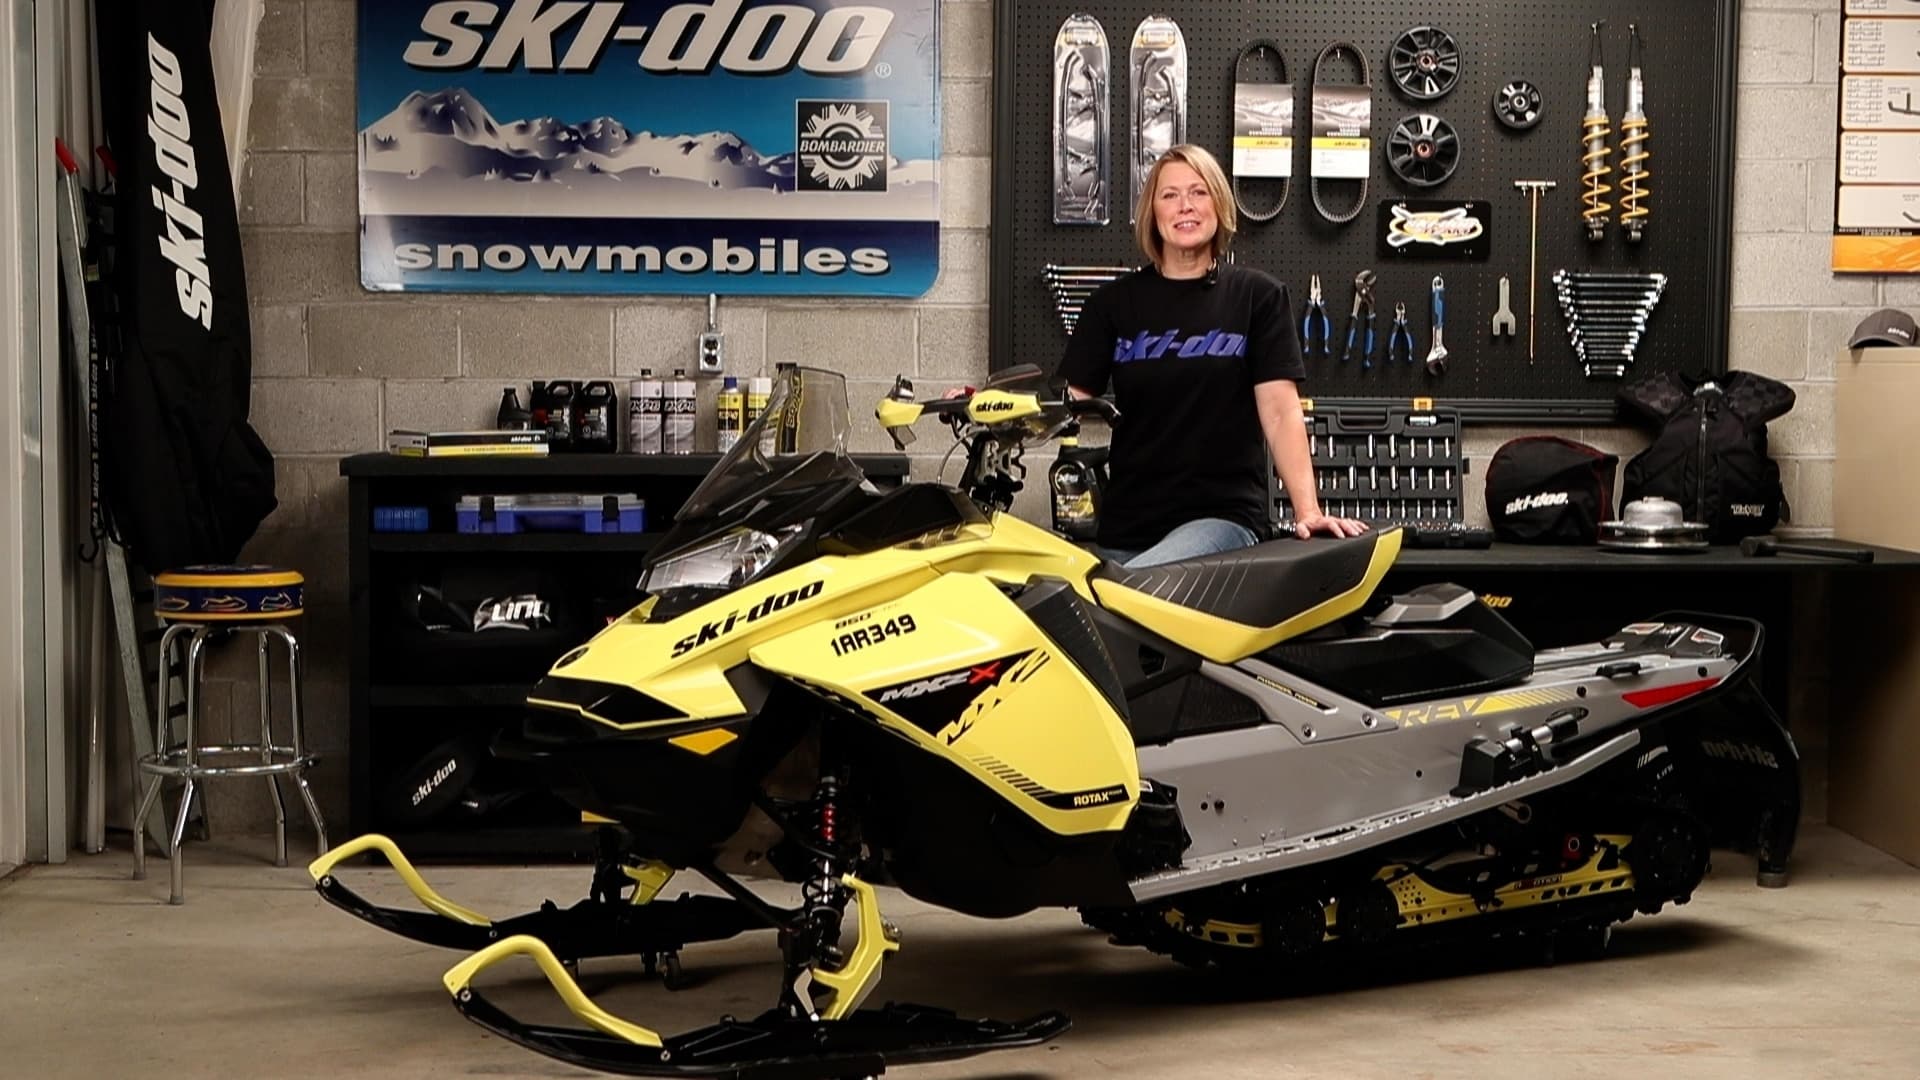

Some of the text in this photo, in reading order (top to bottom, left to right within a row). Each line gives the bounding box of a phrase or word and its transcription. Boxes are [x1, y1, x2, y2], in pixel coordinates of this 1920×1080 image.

[403, 0, 895, 74] ski-doo
[800, 140, 885, 153] BOMBARDIER
[147, 31, 213, 331] ski-doo
[394, 238, 889, 273] snowmobiles
[670, 580, 825, 660] ski-doo
[830, 613, 917, 657] 1AR349
[411, 758, 457, 806] ski-doo
